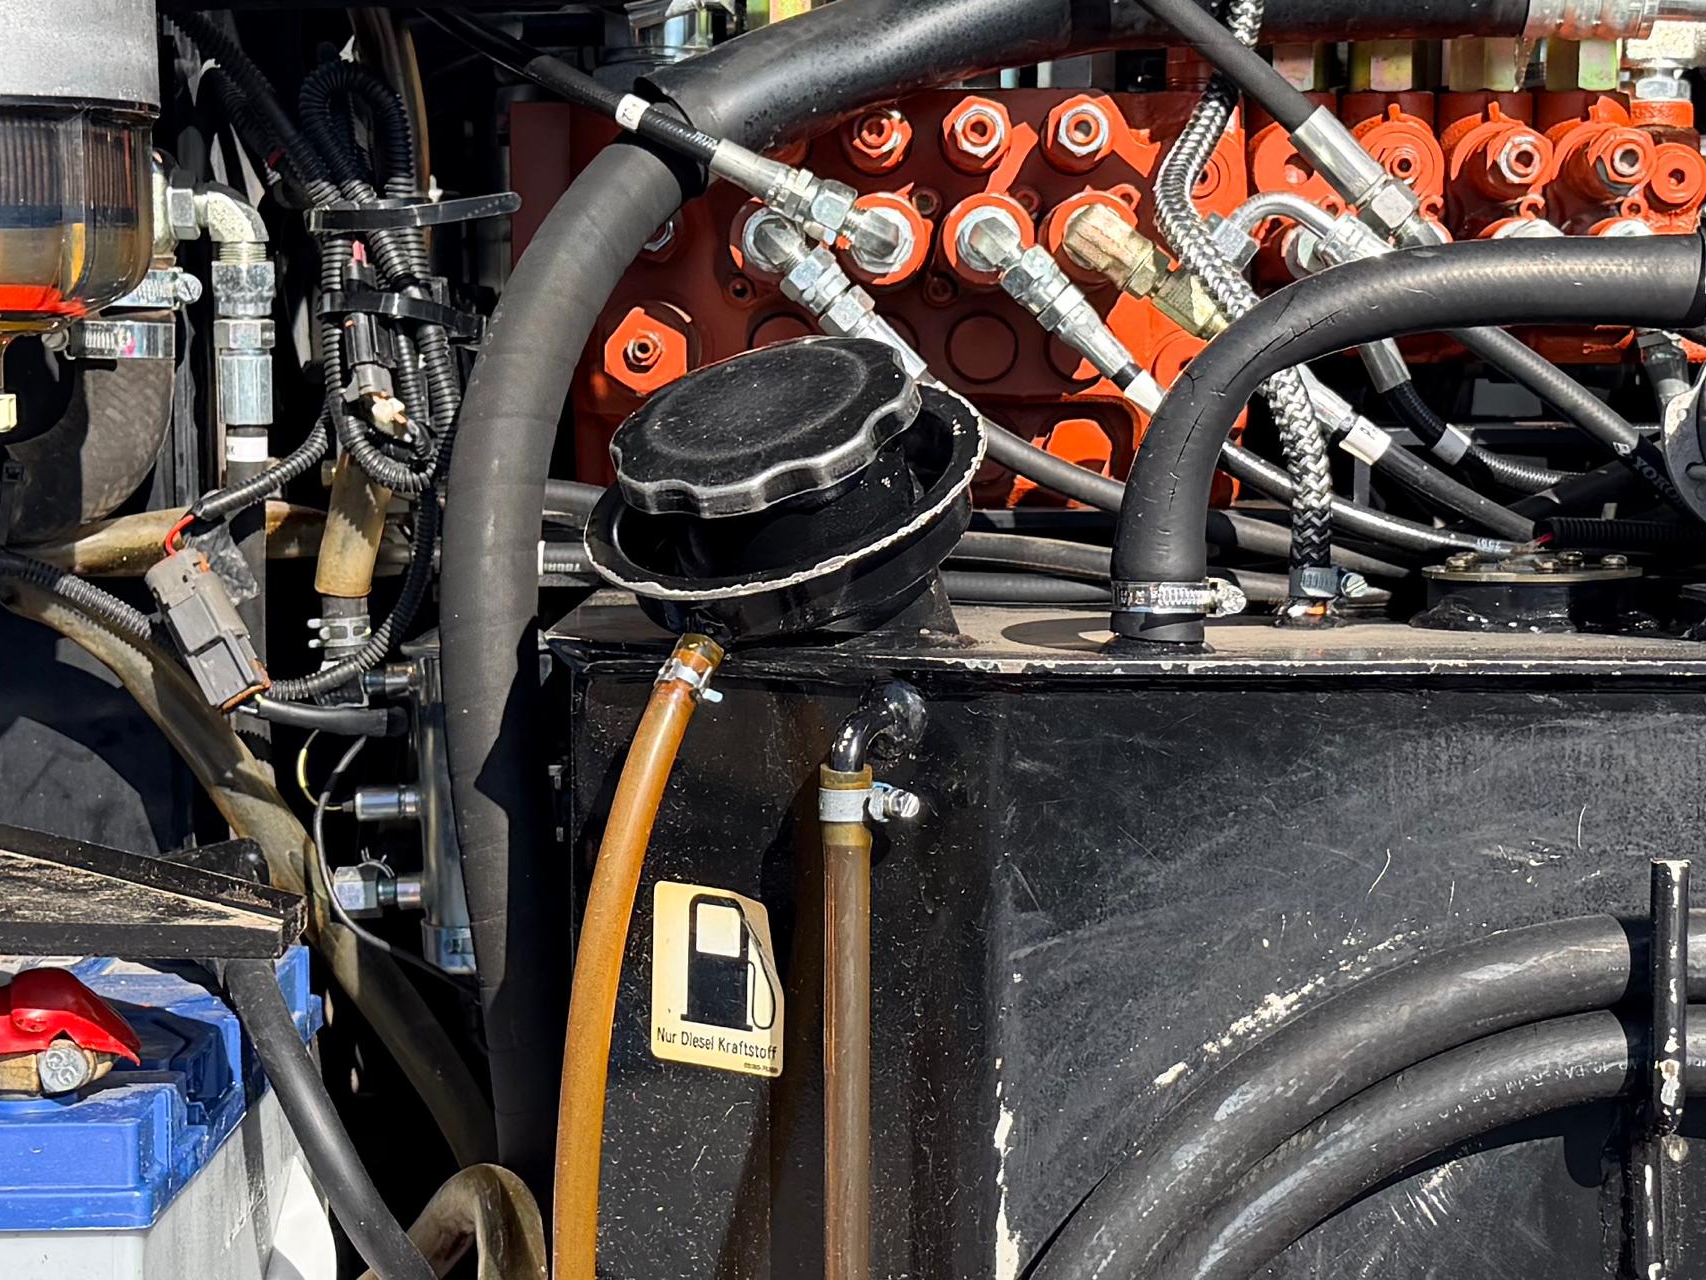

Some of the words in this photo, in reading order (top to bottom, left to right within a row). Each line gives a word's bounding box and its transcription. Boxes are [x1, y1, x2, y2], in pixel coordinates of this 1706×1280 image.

[657, 1027, 677, 1044] Nur
[681, 1031, 714, 1049] Diesel
[719, 1037, 777, 1060] Kraftstoff
